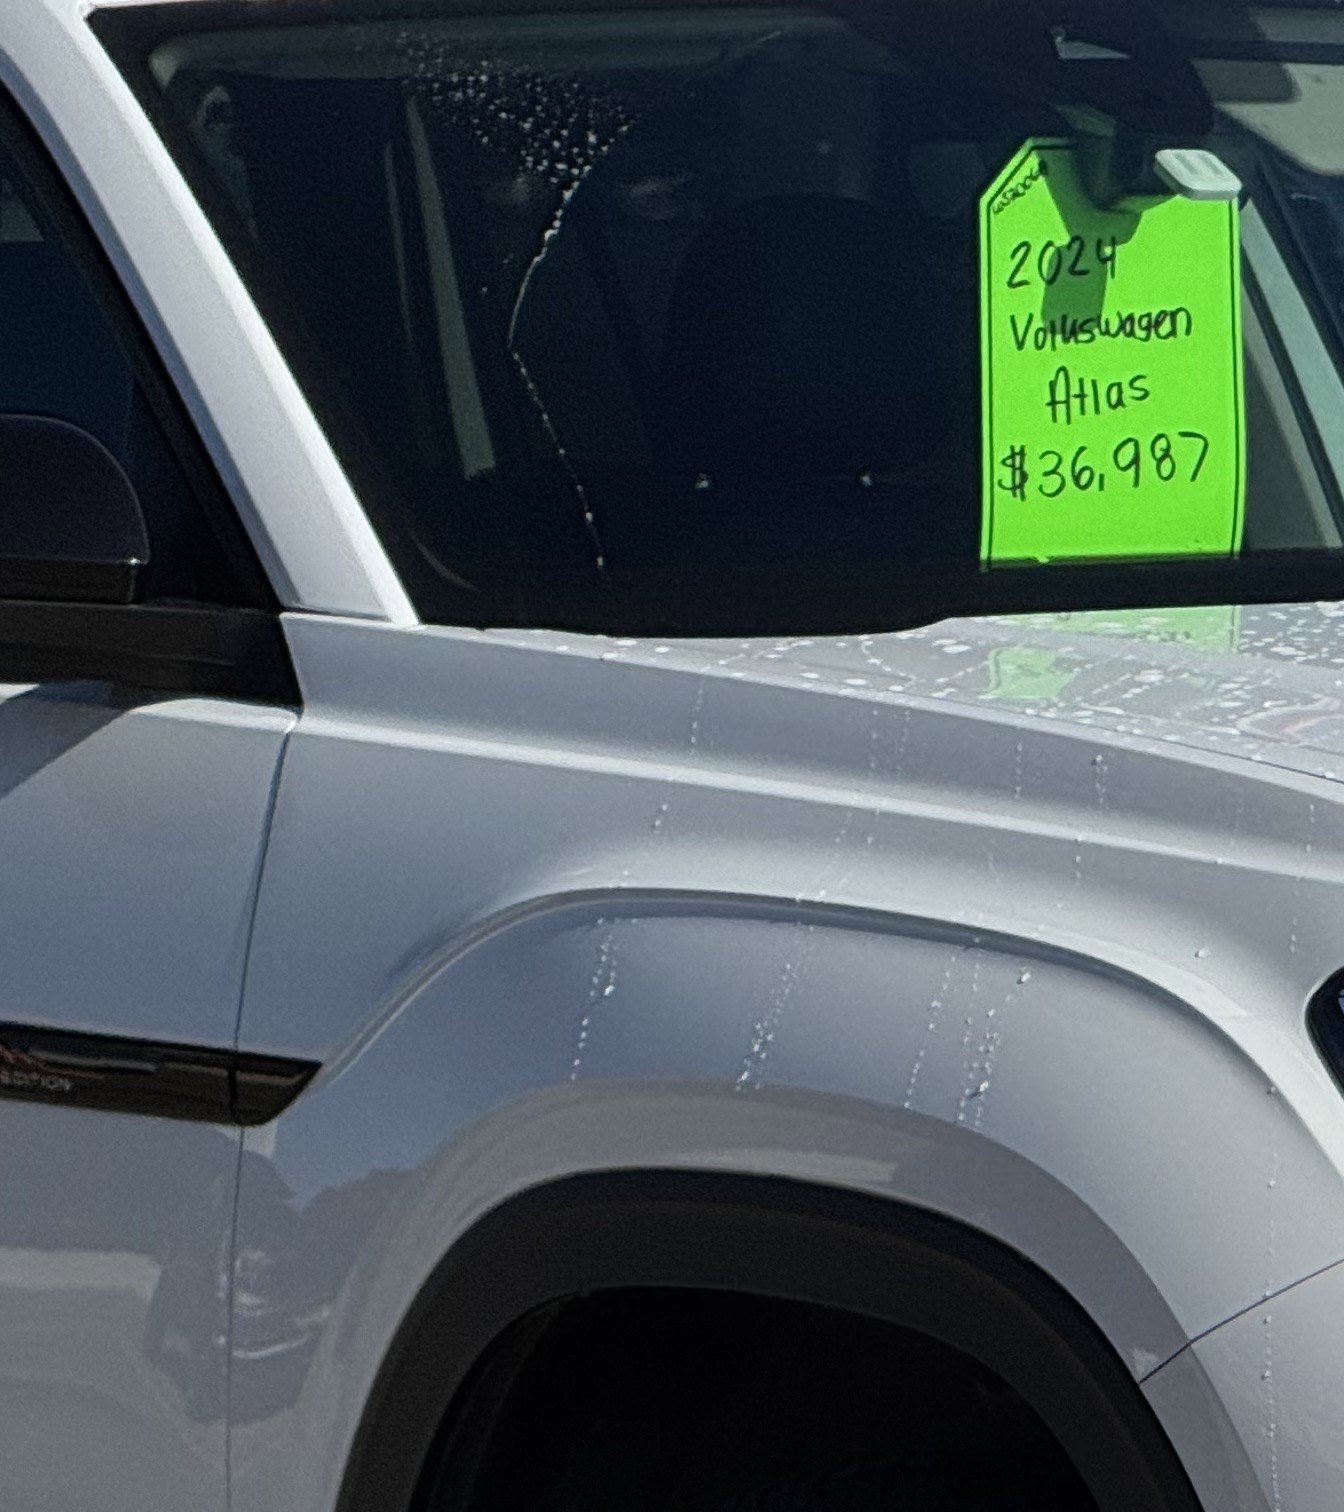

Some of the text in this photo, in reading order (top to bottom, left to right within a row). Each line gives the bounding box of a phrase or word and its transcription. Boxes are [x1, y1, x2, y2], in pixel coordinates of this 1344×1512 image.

[1006, 235, 1118, 289] 2024
[1046, 365, 1150, 425] Atlas
[998, 432, 1209, 500] $36,987
